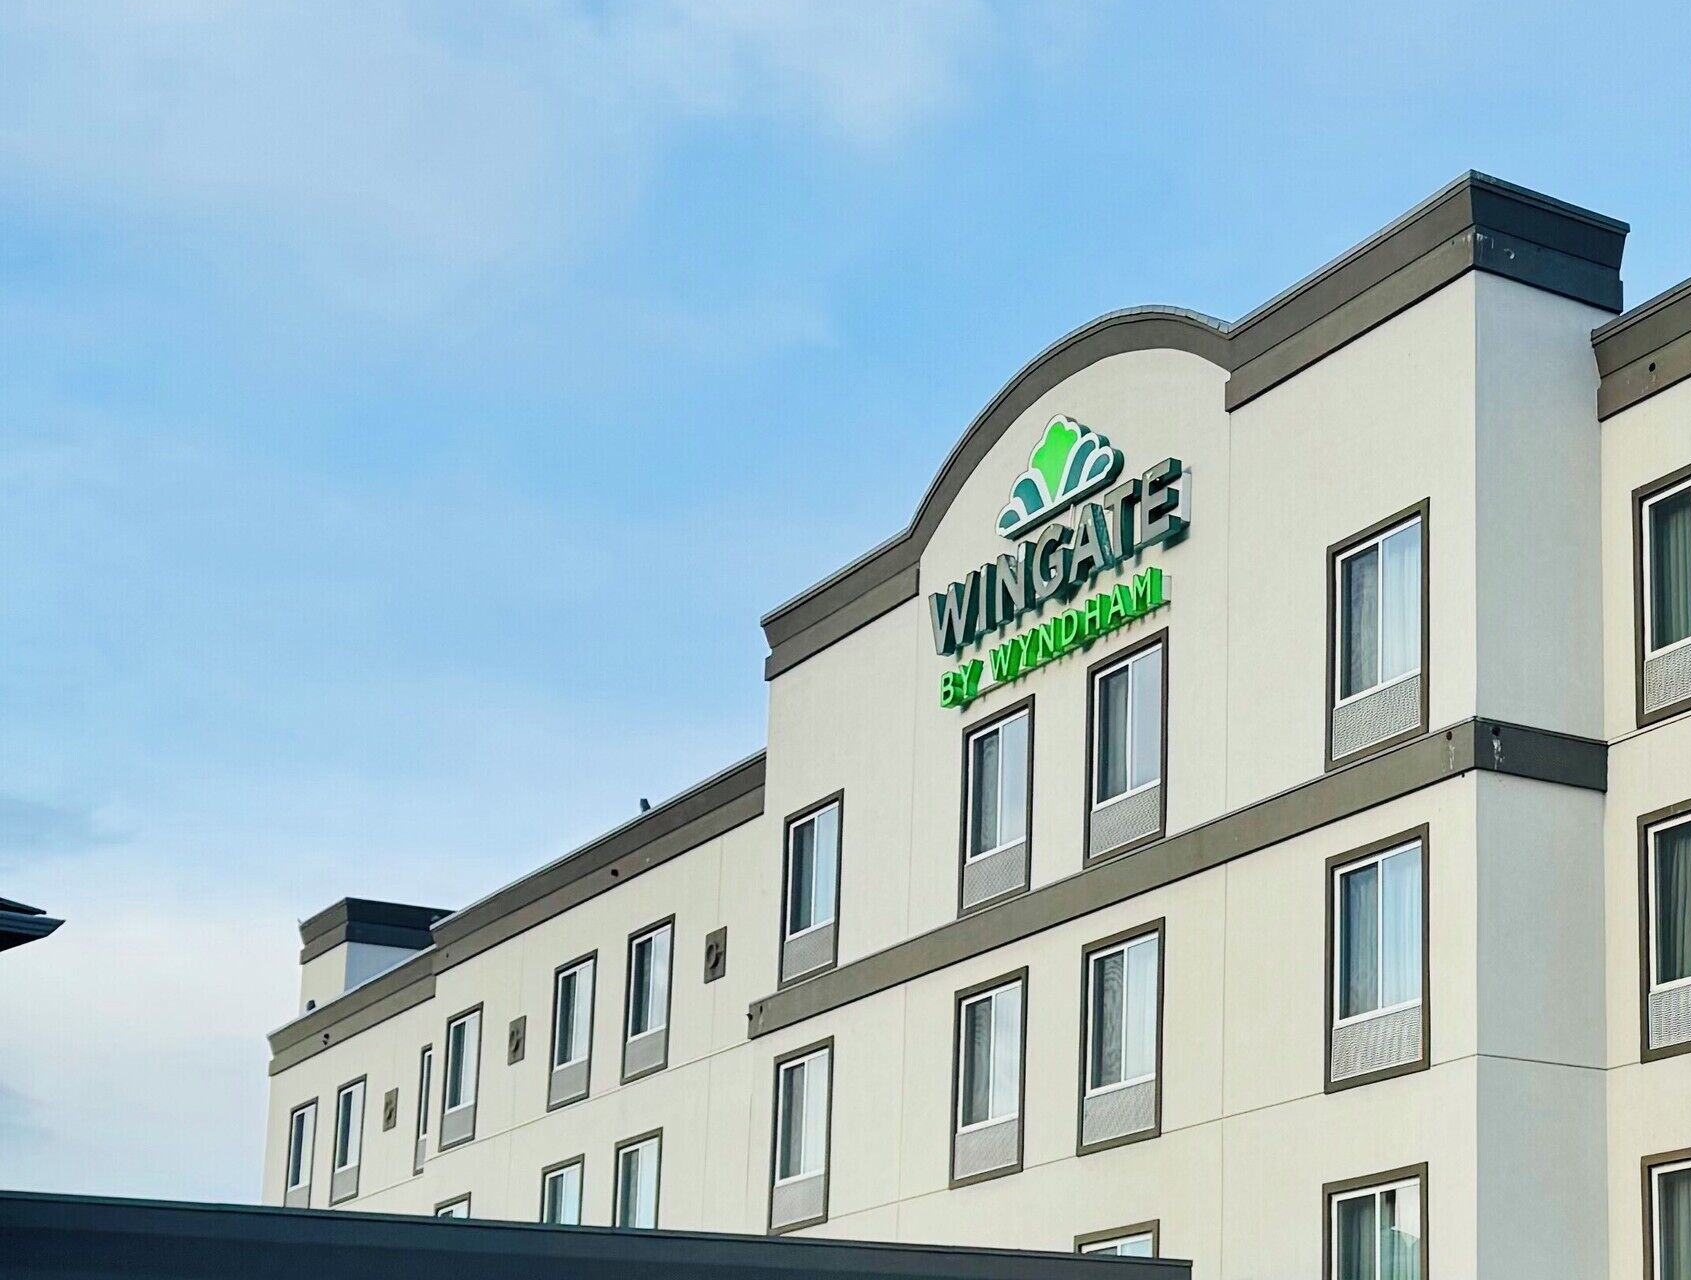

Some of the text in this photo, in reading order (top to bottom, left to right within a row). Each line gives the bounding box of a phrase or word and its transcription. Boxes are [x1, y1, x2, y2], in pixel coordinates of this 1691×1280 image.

[929, 458, 1187, 656] WINGATE
[941, 567, 1162, 708] BY WYNDHAM
